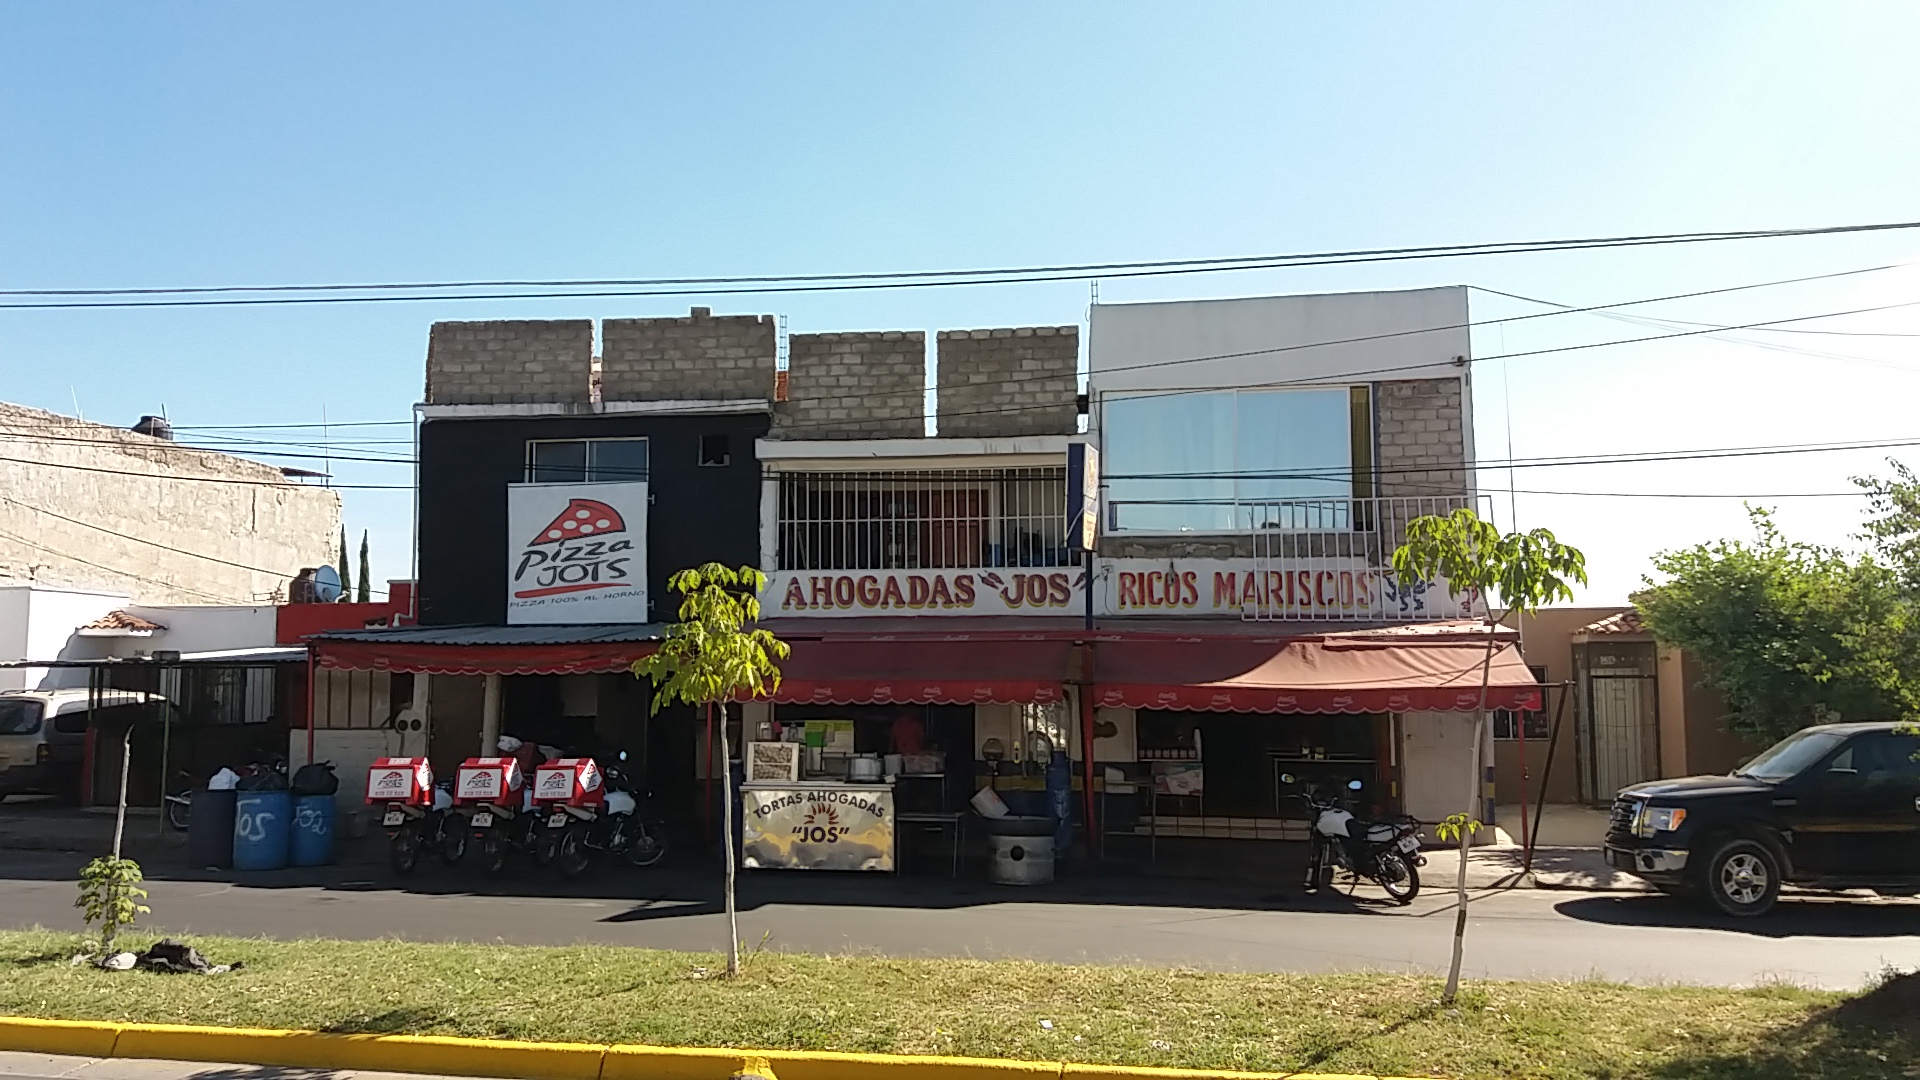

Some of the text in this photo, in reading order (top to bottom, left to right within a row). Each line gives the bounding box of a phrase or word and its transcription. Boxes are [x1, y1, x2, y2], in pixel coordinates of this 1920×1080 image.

[536, 557, 631, 586] JOTS
[509, 599, 546, 608] PIZZA
[551, 596, 579, 604] 100%
[604, 590, 645, 599] HORNO
[781, 574, 976, 609] AHOGADAS
[1118, 570, 1375, 610] RICOS MARISCOS
[753, 791, 885, 819] TORTAS AHOGADAS
